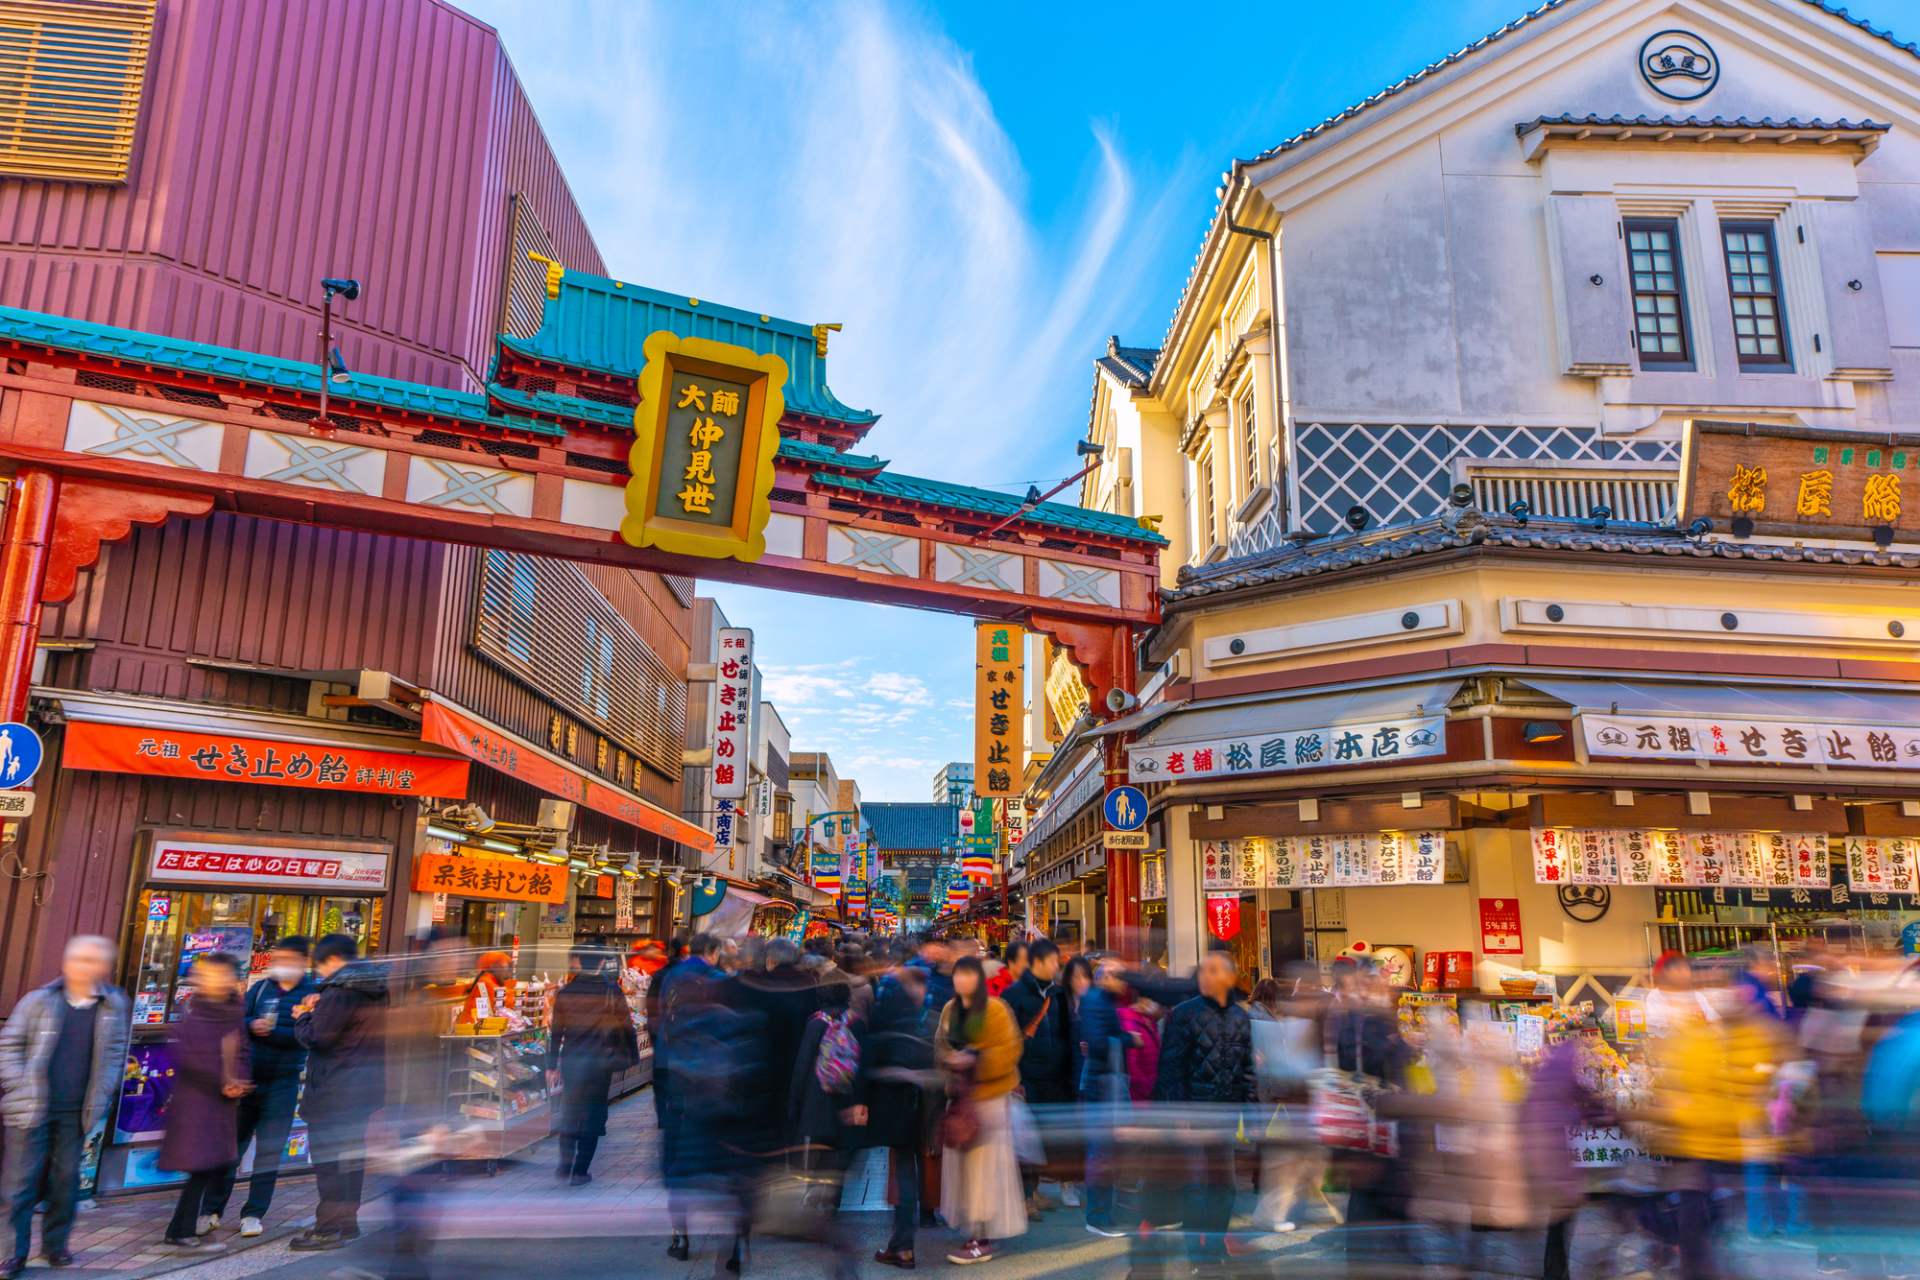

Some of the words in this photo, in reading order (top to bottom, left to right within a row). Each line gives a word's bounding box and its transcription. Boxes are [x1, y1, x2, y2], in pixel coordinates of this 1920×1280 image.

[678, 384, 739, 416] 大師
[676, 417, 724, 514] 仲見世
[723, 638, 745, 648] 元祖
[714, 657, 739, 785] せき止め飴
[736, 687, 748, 724] 評判堂
[987, 687, 1011, 791] せき止飴
[1165, 749, 1213, 775] 老舗
[1226, 727, 1400, 771] 松屋総本店
[1636, 724, 1696, 752] 元祖
[1740, 726, 1898, 763] せき止飴
[139, 738, 180, 758] 元祖
[189, 744, 349, 783] せき止め飴
[355, 769, 416, 789] 評判堂
[161, 851, 339, 877] たばこは心の日曜日
[433, 864, 552, 896] 呆気封じ飴
[1380, 833, 1397, 882] きなこ飴
[1417, 831, 1434, 881] せき止飴
[1770, 835, 1789, 885] きなこ飴
